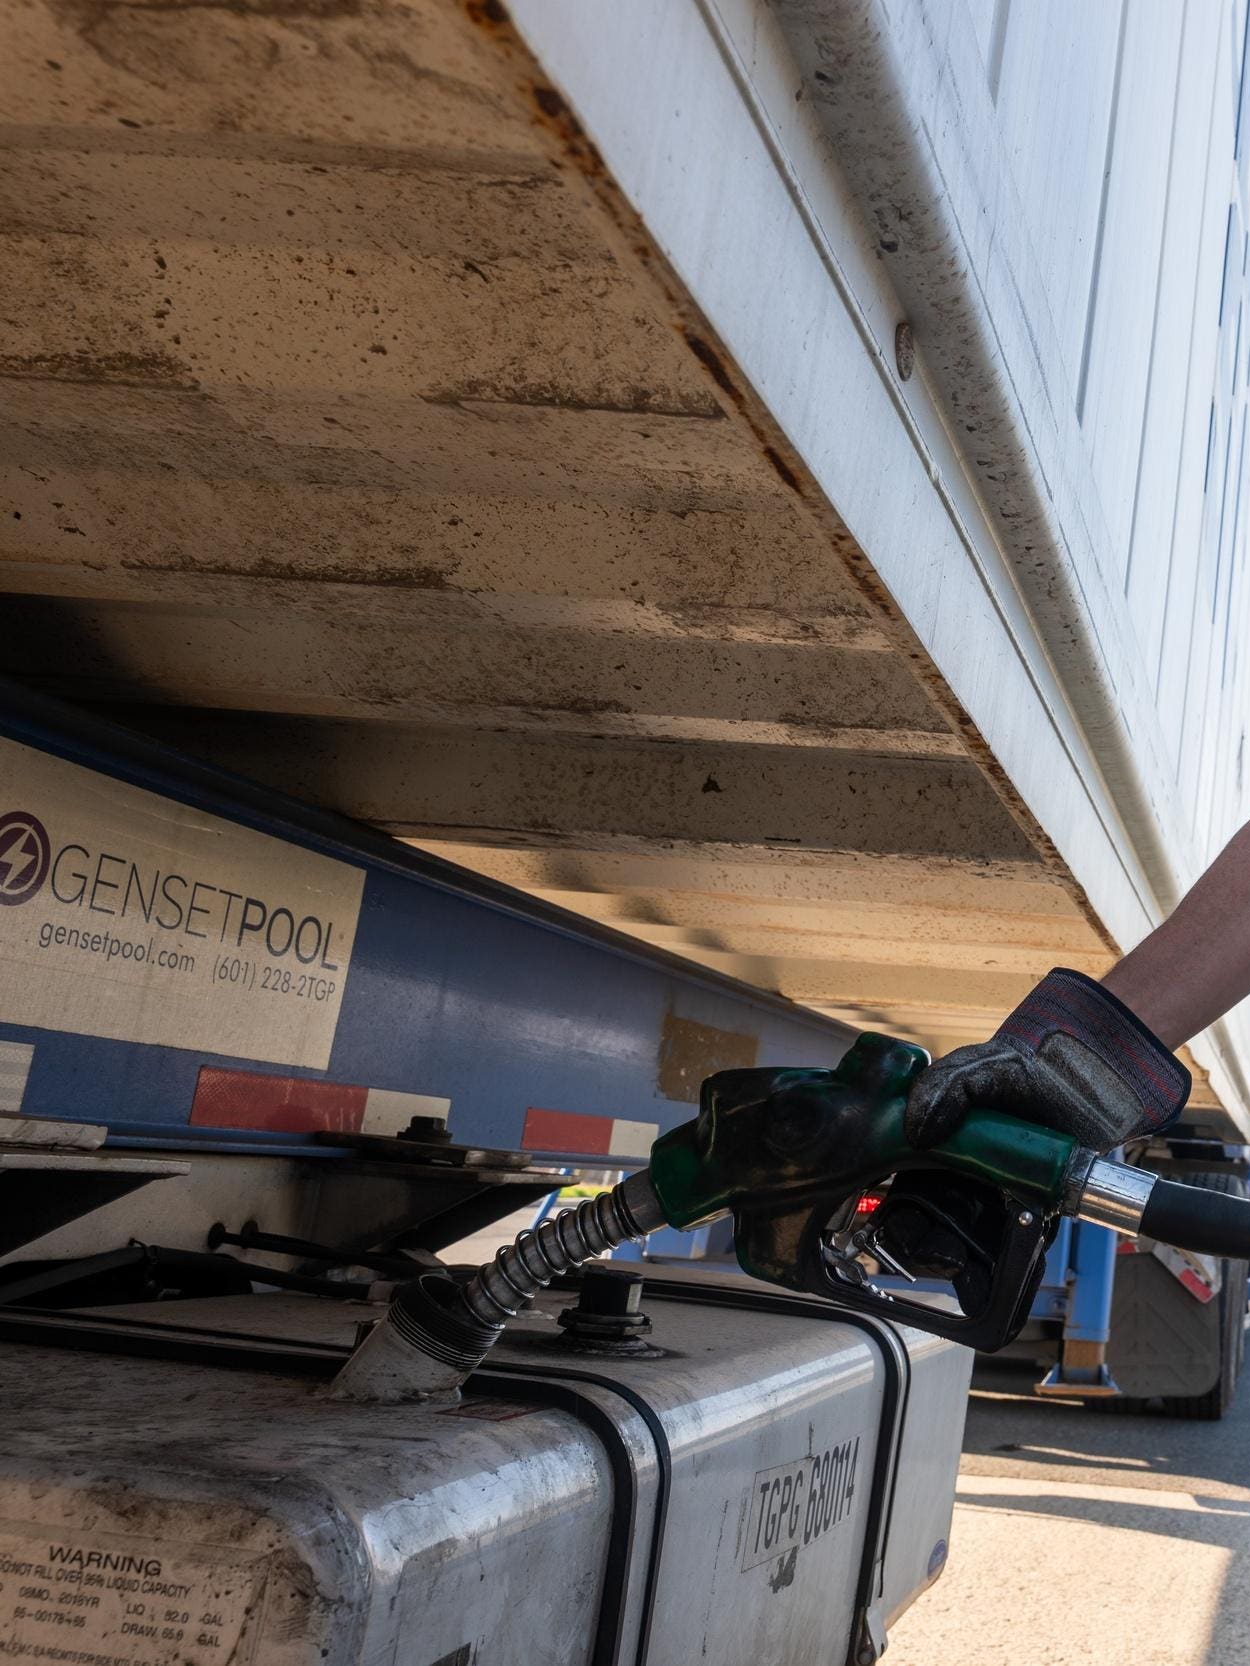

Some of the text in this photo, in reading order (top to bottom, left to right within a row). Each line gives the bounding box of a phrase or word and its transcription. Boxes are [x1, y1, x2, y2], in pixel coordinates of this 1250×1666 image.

[51, 844, 338, 971] GENSETPOOL
[38, 921, 336, 1003] gensetpool.com (601) 228-2TGP
[803, 1436, 861, 1545] 680114
[49, 1545, 162, 1577] WARNING
[55, 1567, 83, 1584] OVER
[106, 1576, 140, 1593] LIQUID
[141, 1580, 192, 1599] CAPACITY
[120, 1621, 158, 1638] DRAW
[198, 1633, 221, 1648] GAL
[201, 1611, 224, 1627] GAL
